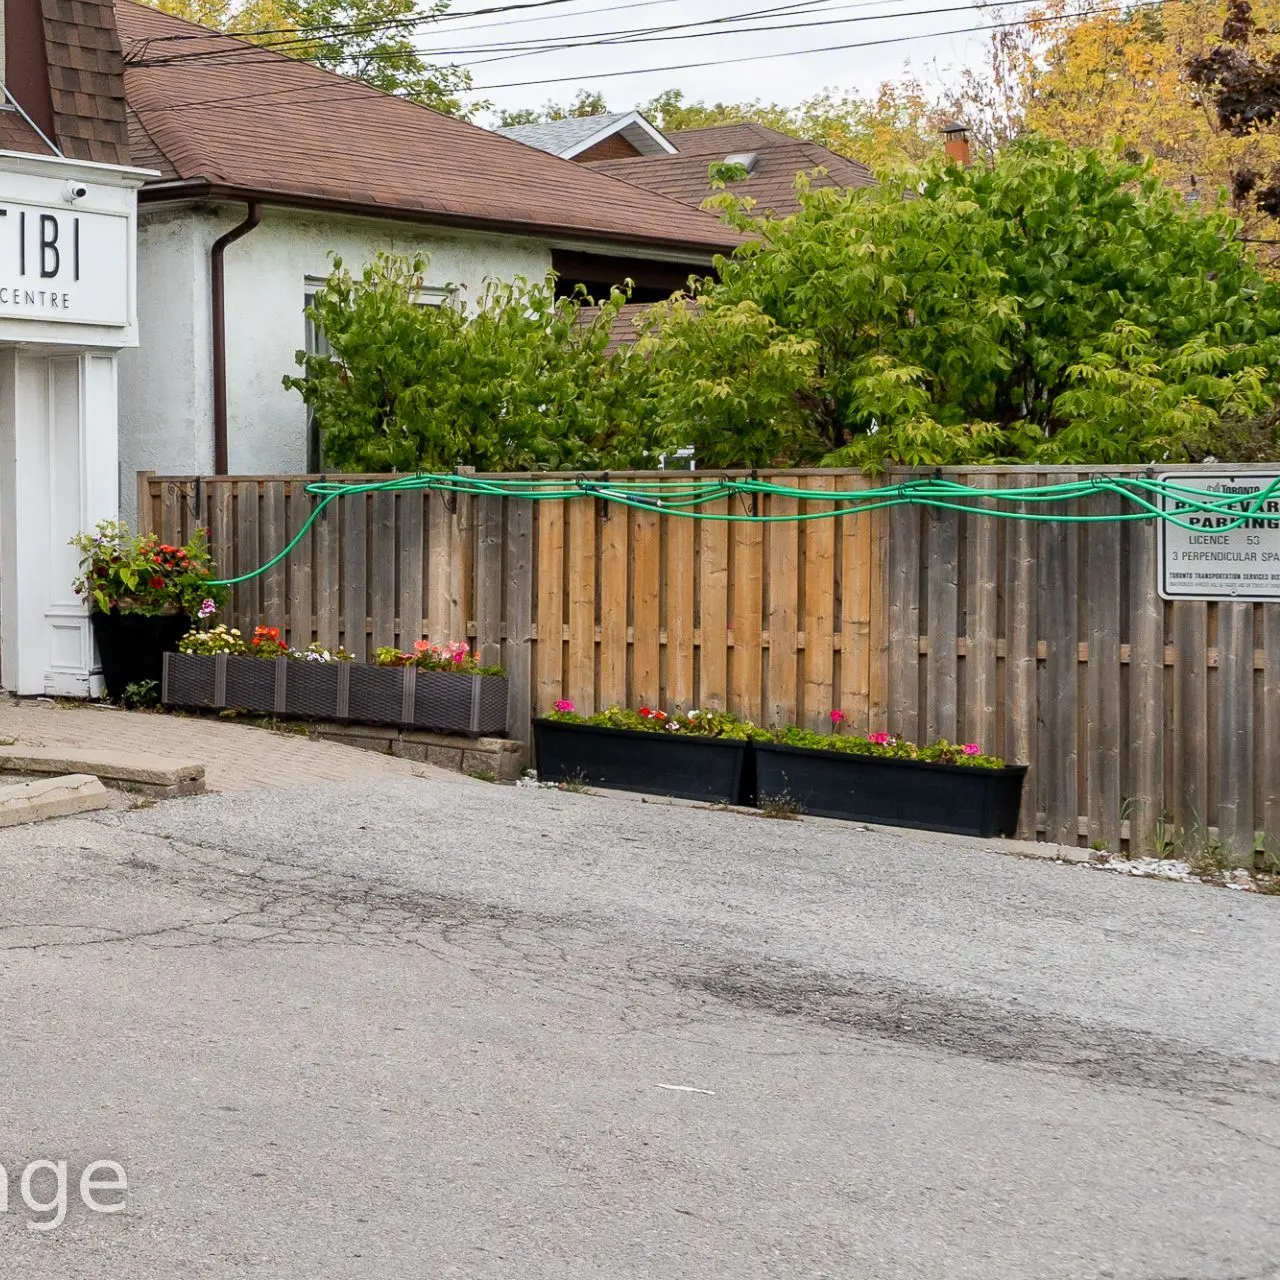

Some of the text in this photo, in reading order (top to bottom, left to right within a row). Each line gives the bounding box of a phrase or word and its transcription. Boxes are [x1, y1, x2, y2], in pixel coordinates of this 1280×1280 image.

[0, 287, 70, 309] CENTRE
[1174, 501, 1280, 513] BEVAR
[1189, 535, 1260, 545] LICENCE 53
[1172, 551, 1178, 560] 3
[1182, 551, 1257, 561] PERPENDICULAR
